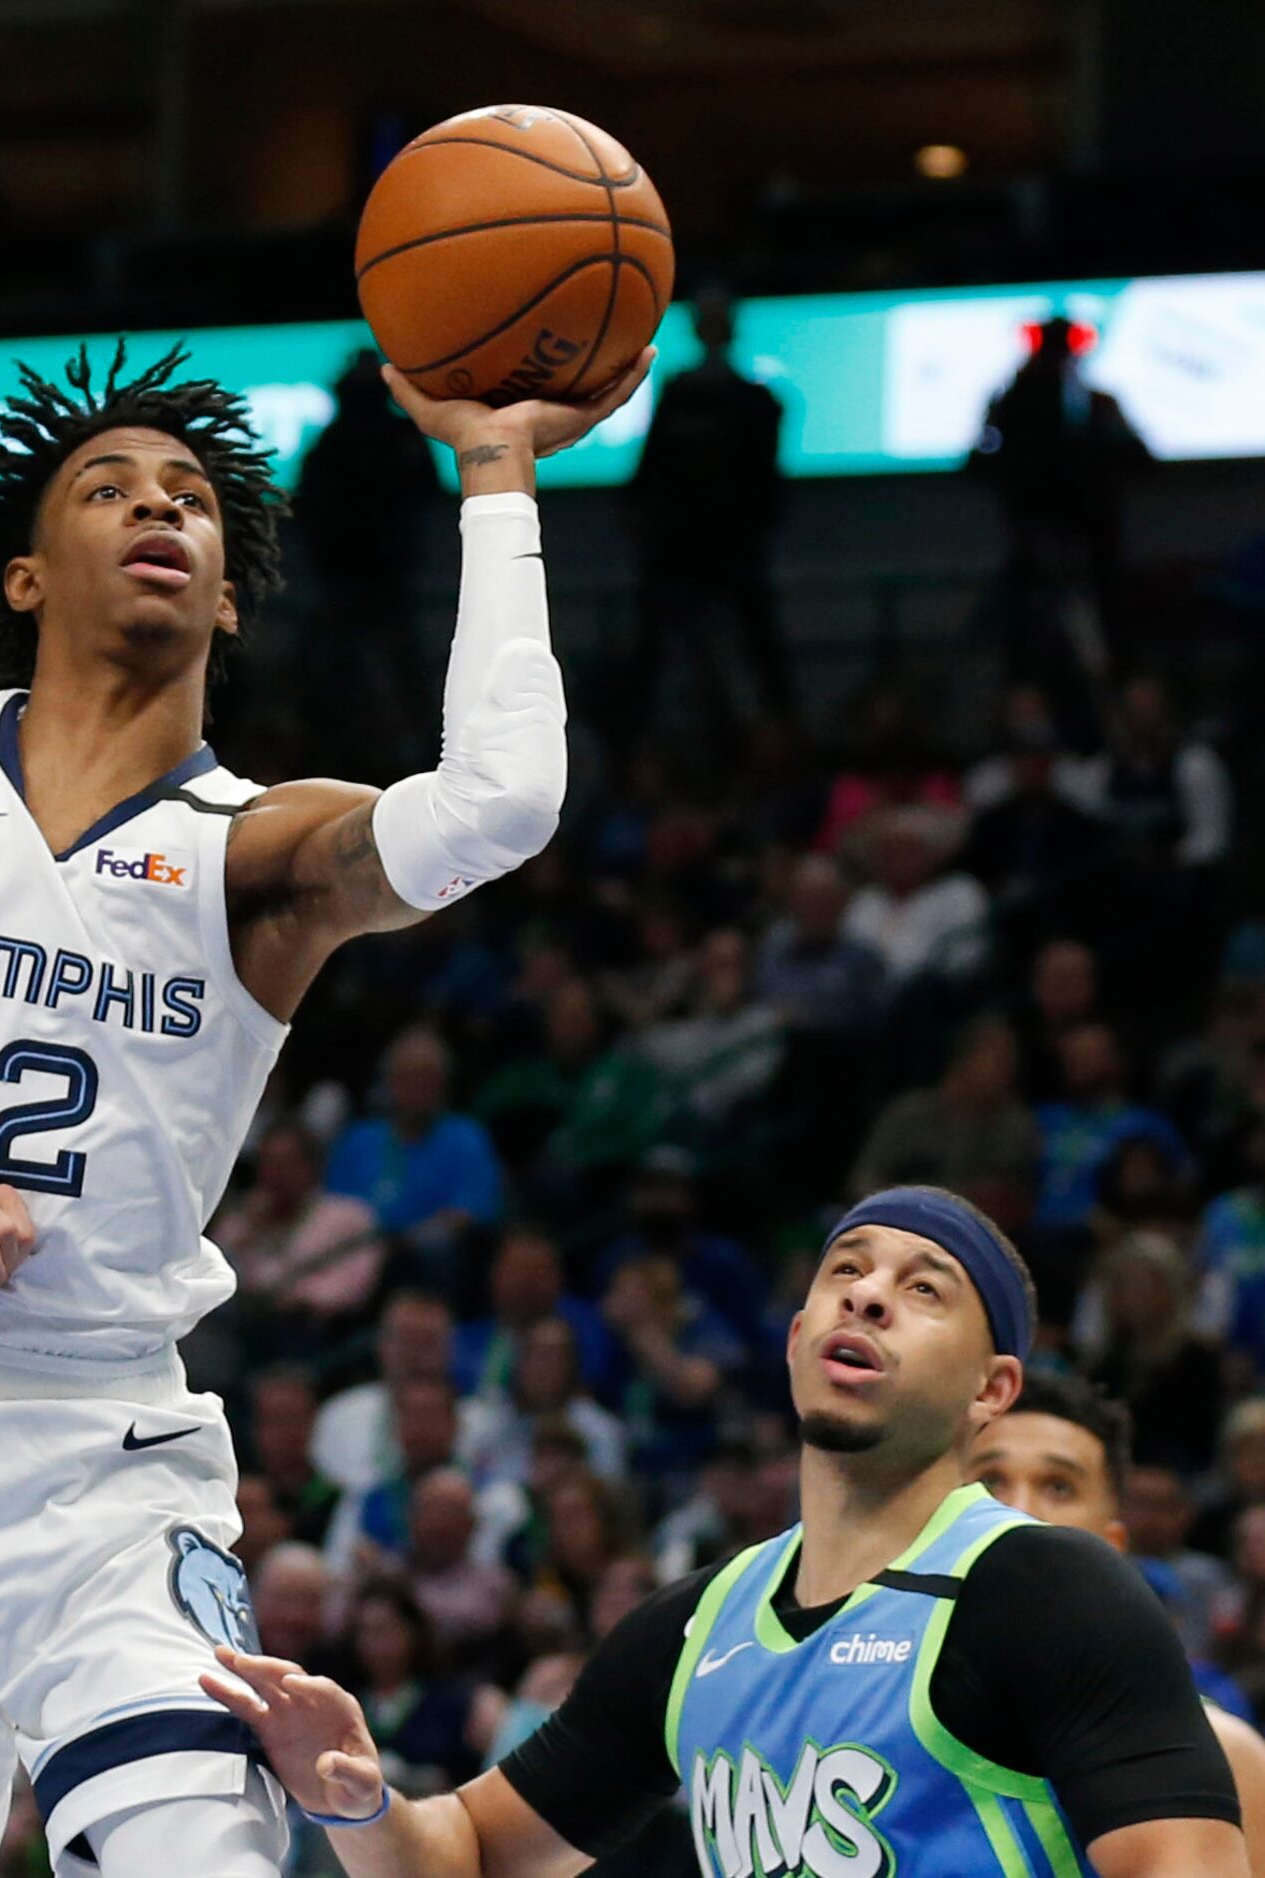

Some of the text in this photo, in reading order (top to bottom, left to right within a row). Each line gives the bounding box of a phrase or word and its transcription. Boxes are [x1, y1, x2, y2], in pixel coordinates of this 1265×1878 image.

[95, 848, 188, 886] FedEx
[830, 1632, 912, 1665] chime
[690, 1735, 899, 1878] MAVS
